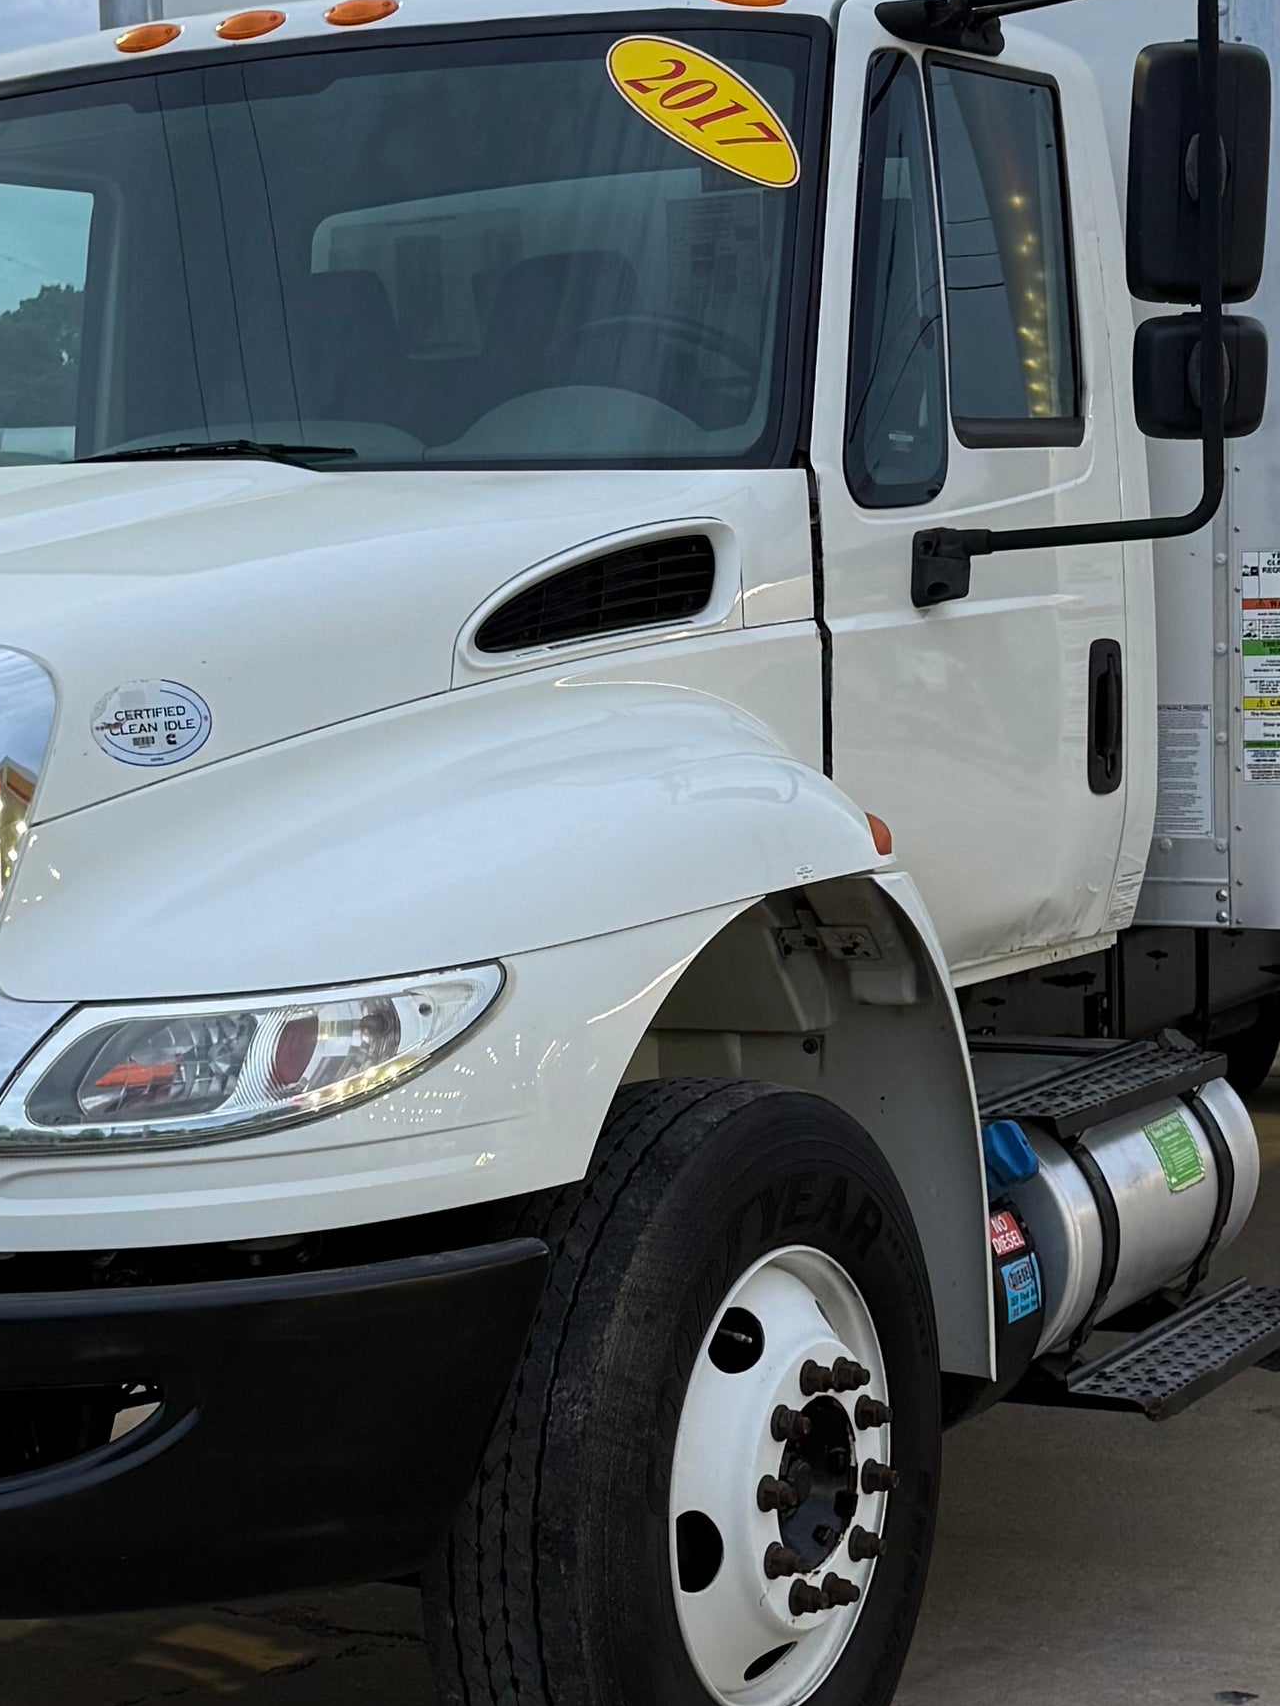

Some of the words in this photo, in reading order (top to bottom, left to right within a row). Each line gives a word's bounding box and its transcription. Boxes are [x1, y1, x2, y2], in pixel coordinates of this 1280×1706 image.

[624, 58, 783, 146] 2017
[114, 705, 186, 722] CERTIFIED
[110, 722, 159, 736] CLEAN
[164, 718, 196, 731] IDLE
[990, 1216, 1008, 1234] NO
[991, 1230, 1026, 1255] DIESEL
